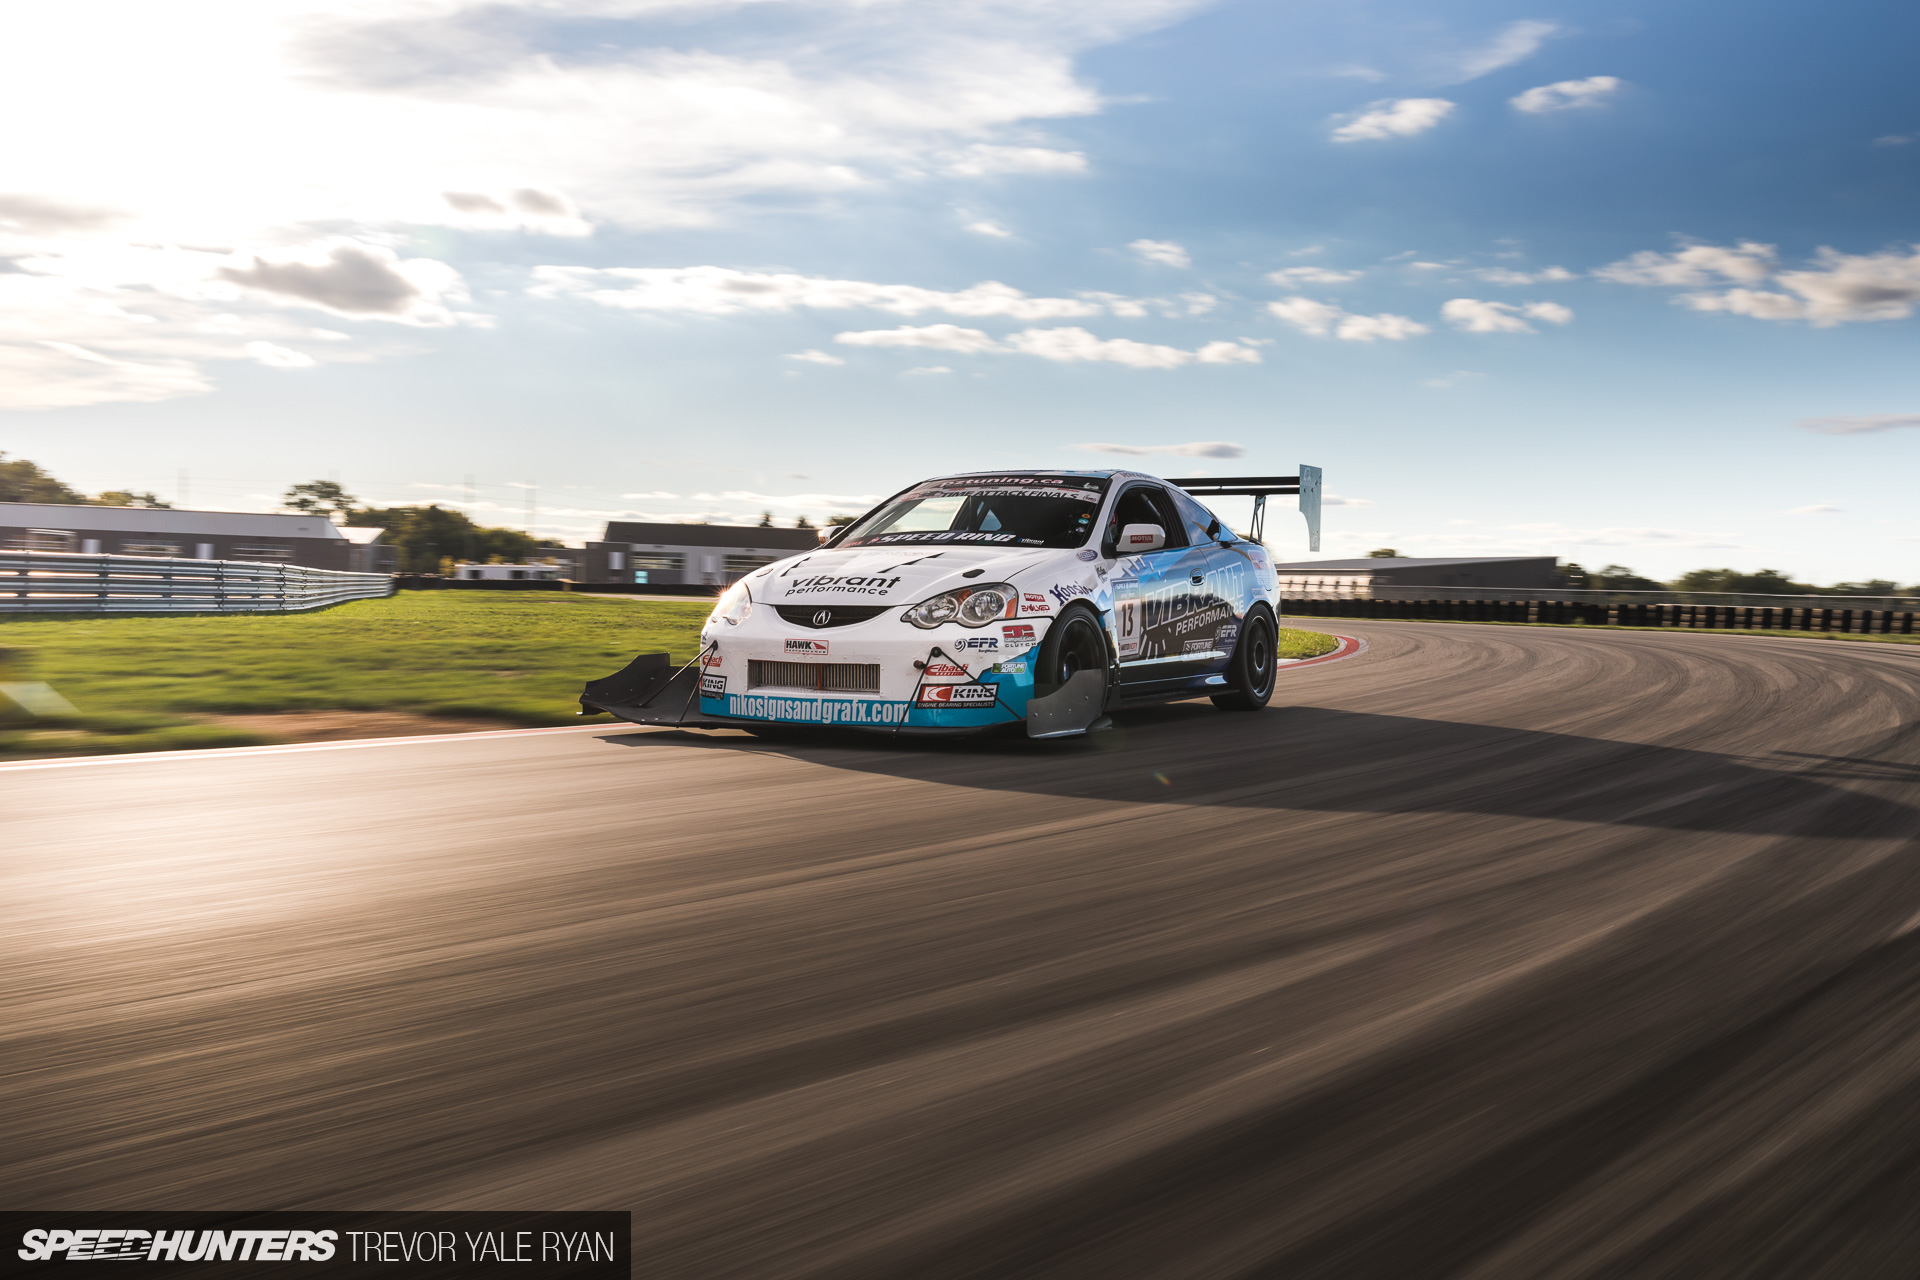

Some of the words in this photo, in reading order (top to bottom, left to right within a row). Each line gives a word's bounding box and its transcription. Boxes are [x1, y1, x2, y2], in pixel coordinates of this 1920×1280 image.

[1029, 490, 1079, 499] FINALS
[878, 532, 955, 544] SPEED
[953, 532, 1016, 542] RING
[791, 575, 902, 589] vibrant
[785, 585, 889, 597] performance
[1145, 561, 1245, 631] VIBRANT
[1121, 603, 1134, 637] 13
[1175, 600, 1245, 636] PERFORMANCE
[1220, 624, 1237, 638] EFR
[786, 640, 812, 650] HAWK
[967, 637, 999, 648] EFR
[1190, 641, 1212, 651] FORTUNE
[953, 688, 995, 699] KING
[729, 693, 910, 724] nikosignsandgrafx.com
